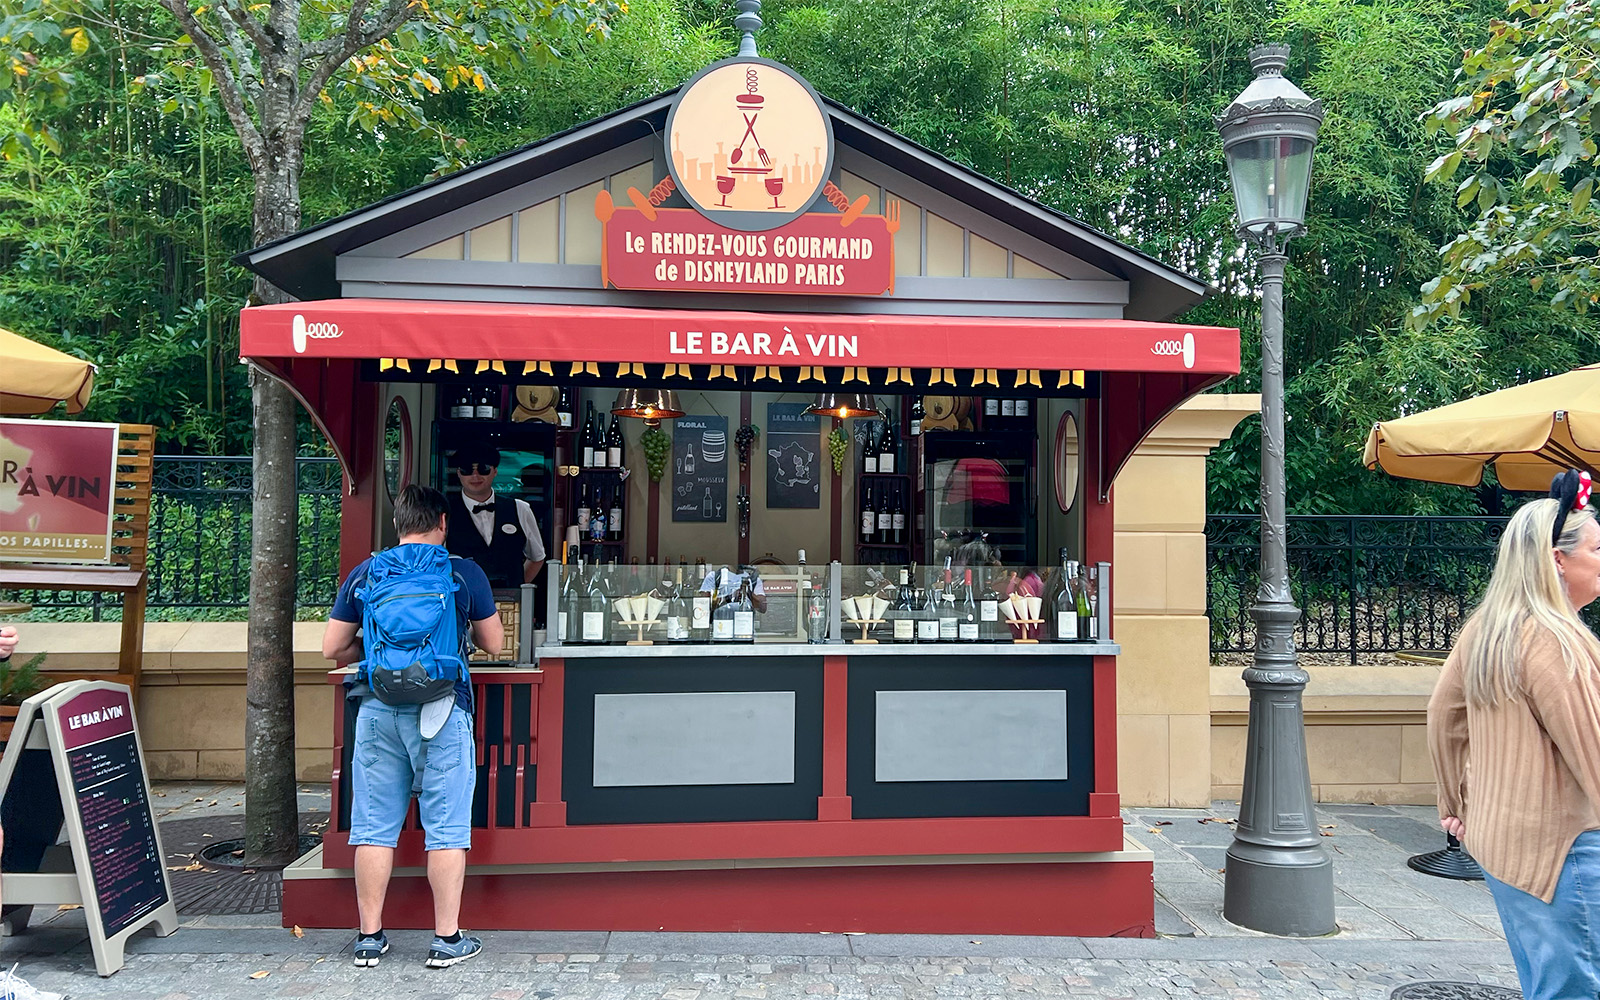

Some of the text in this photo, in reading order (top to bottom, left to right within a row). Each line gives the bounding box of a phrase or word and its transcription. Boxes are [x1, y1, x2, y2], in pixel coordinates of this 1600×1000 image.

[625, 231, 873, 260] Le RENDEZ-VOUS GOURMAND
[655, 258, 846, 286] de DISNEYLAND PARIS
[669, 325, 859, 358] LE BAR À VIN
[677, 421, 707, 429] FLORAL
[18, 467, 40, 497] À
[45, 475, 101, 499] VIN
[23, 536, 104, 549] PAPILLES...
[68, 704, 124, 730] LE BAR À VIN
